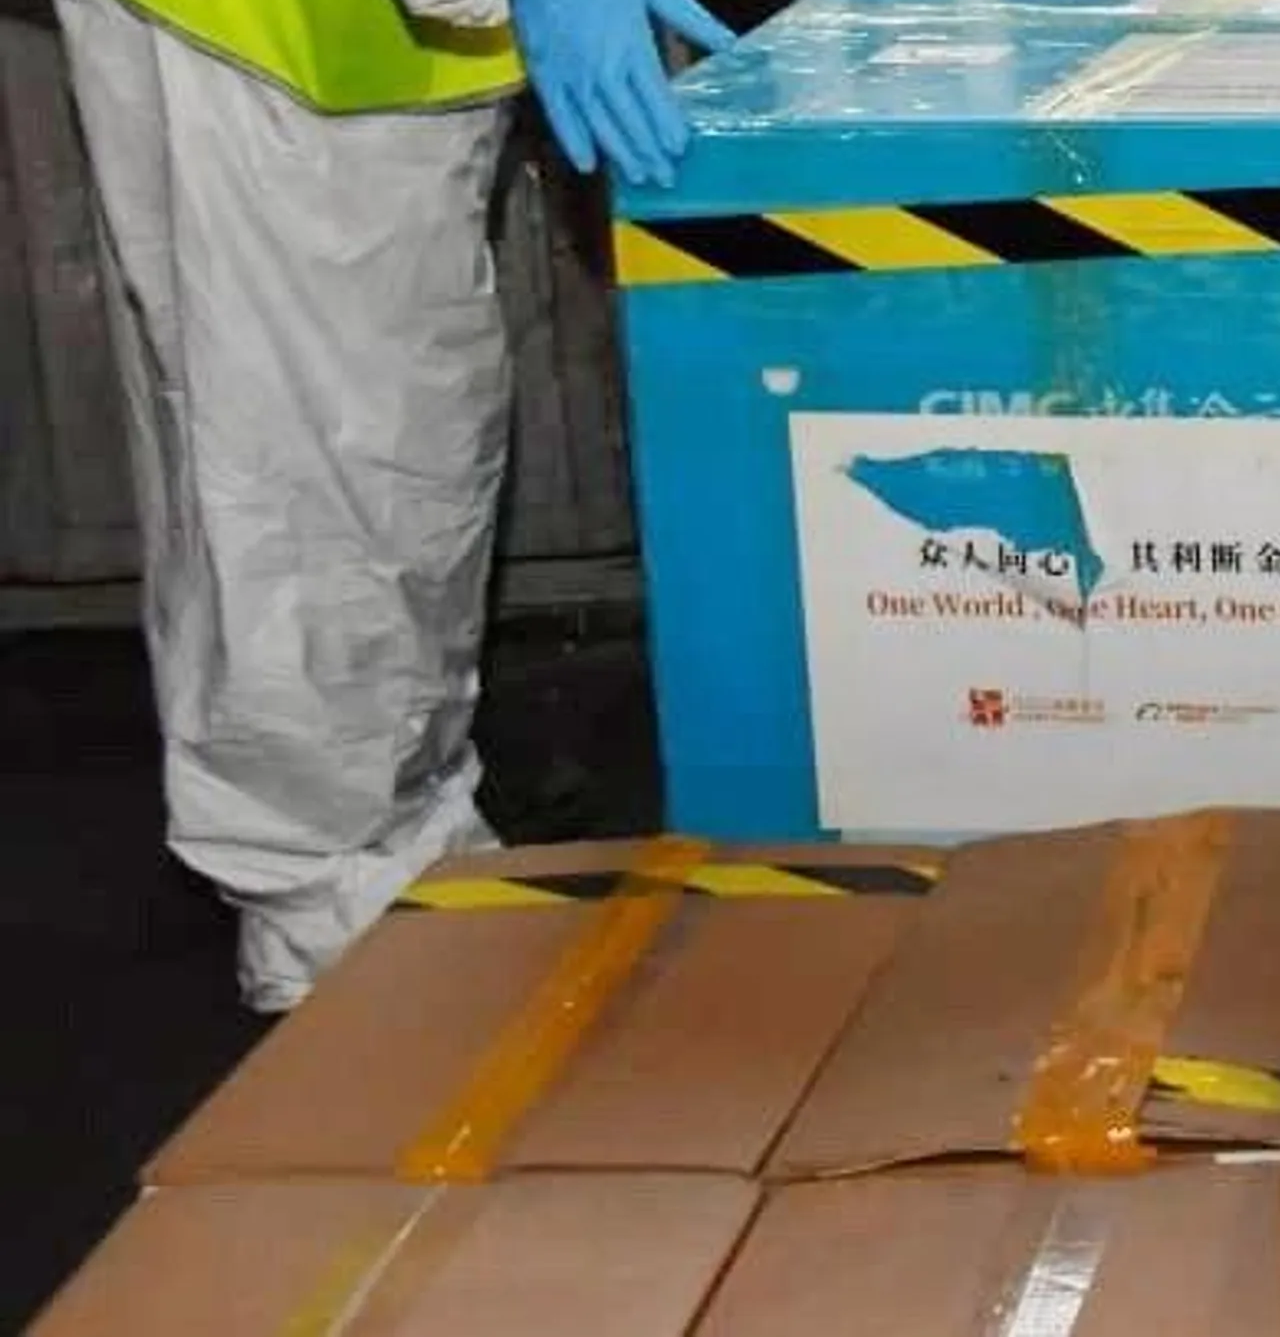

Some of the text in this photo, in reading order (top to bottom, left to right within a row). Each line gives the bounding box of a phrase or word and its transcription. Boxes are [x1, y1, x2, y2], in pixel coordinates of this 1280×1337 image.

[867, 591, 924, 616] One
[1116, 593, 1208, 624] Heart,
[1215, 596, 1276, 621] One
